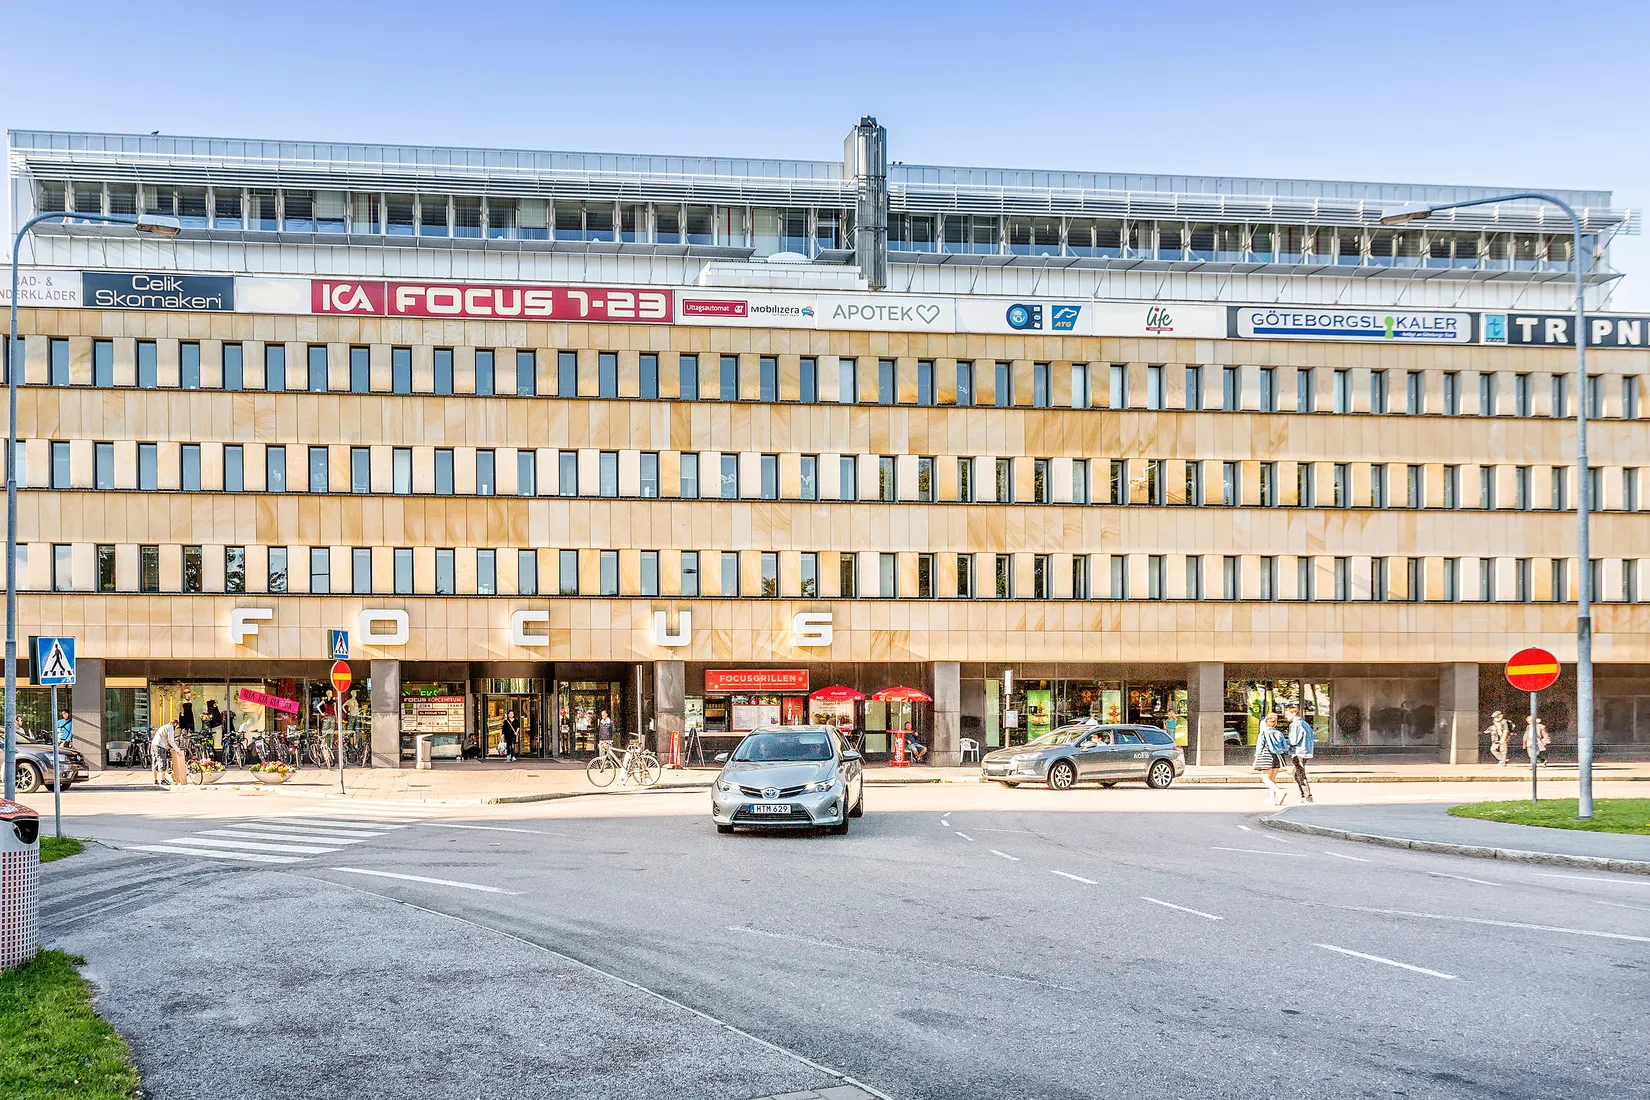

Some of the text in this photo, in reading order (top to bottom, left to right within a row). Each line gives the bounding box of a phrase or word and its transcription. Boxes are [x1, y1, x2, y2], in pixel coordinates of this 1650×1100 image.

[46, 276, 53, 287] &
[132, 275, 184, 292] Celik
[95, 289, 223, 309] Skomakeri
[322, 283, 375, 312] ICA
[395, 286, 554, 316] FOCUS
[686, 303, 730, 312] Uttagsautomat
[832, 304, 914, 322] APOTEK
[1515, 317, 1650, 345] TRPN
[719, 674, 797, 683] FOCUSGRILLEN
[756, 805, 788, 813] HTM 629
